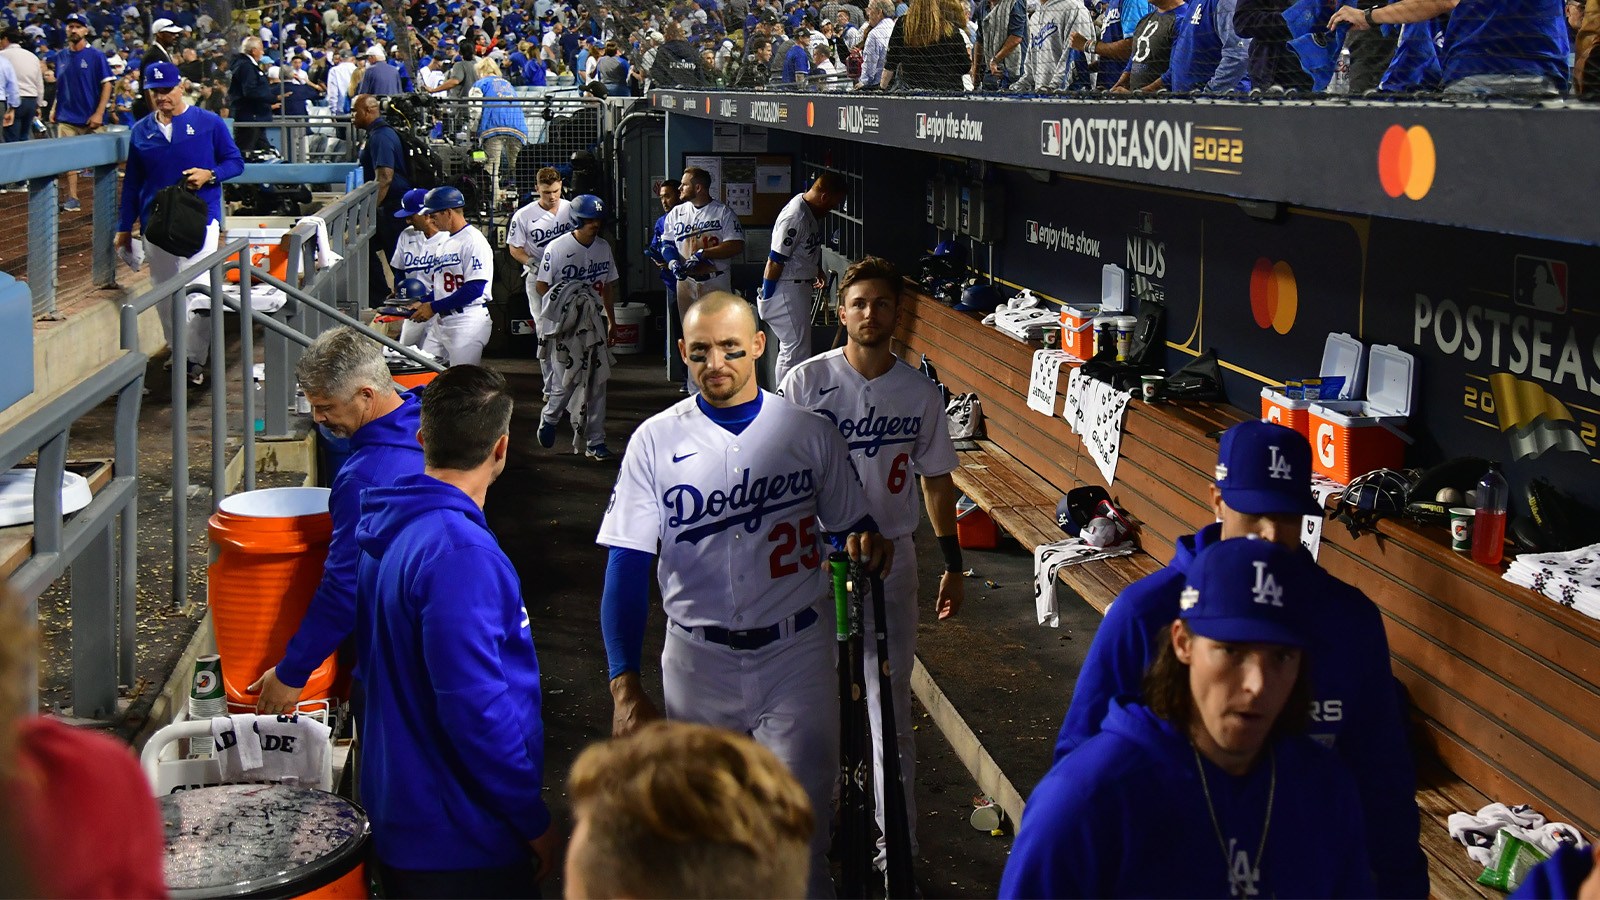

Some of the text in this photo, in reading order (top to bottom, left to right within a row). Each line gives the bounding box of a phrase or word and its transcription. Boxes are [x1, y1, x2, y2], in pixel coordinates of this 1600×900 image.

[1132, 20, 1158, 62] B
[153, 67, 164, 79] LA
[186, 123, 196, 136] LA
[846, 105, 879, 134] NLDS 2022
[926, 110, 983, 143] enjoy the show.
[1061, 118, 1243, 174] POSTSEASON 2022
[594, 201, 603, 211] LA
[1038, 222, 1100, 258] enjoy the show.
[1126, 235, 1166, 279] NLDS
[471, 256, 482, 271] LA
[1065, 317, 1079, 348] G
[1268, 446, 1293, 480] LA
[1317, 423, 1335, 468] G
[887, 452, 910, 495] 6
[663, 468, 814, 534] Dodgers
[767, 515, 820, 579] 25
[1252, 561, 1284, 607] LA
